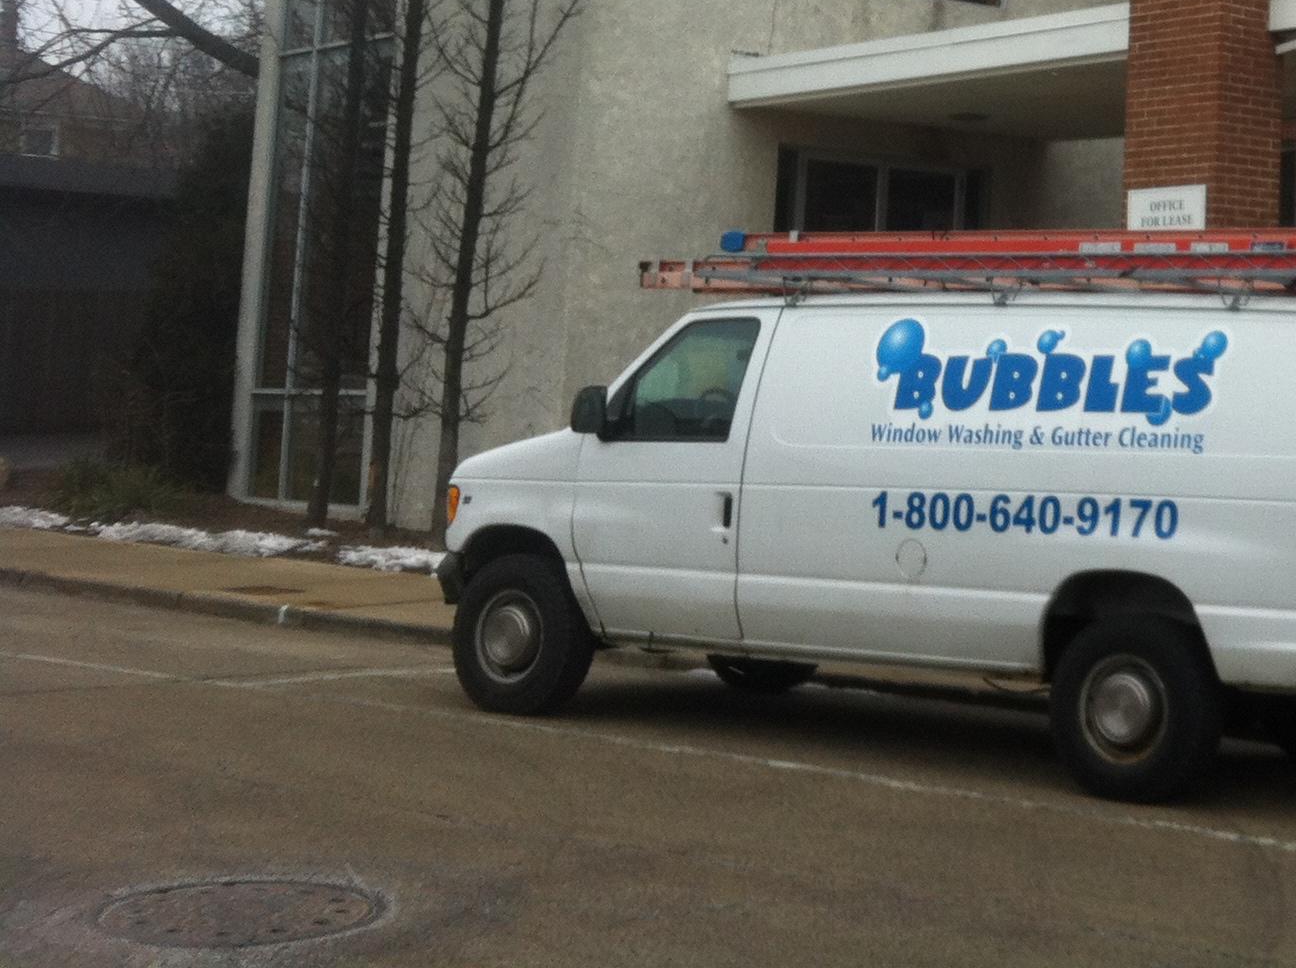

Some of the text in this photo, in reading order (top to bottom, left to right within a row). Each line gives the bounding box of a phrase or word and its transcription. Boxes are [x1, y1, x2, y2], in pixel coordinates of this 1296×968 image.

[1141, 214, 1192, 227] FOR LEASE
[1149, 199, 1185, 212] OFFICE
[893, 352, 1215, 415] BUBBLES
[870, 423, 1204, 454] Window Washing & Gutter Cleaning
[872, 490, 1179, 540] 1-800-640-9170
